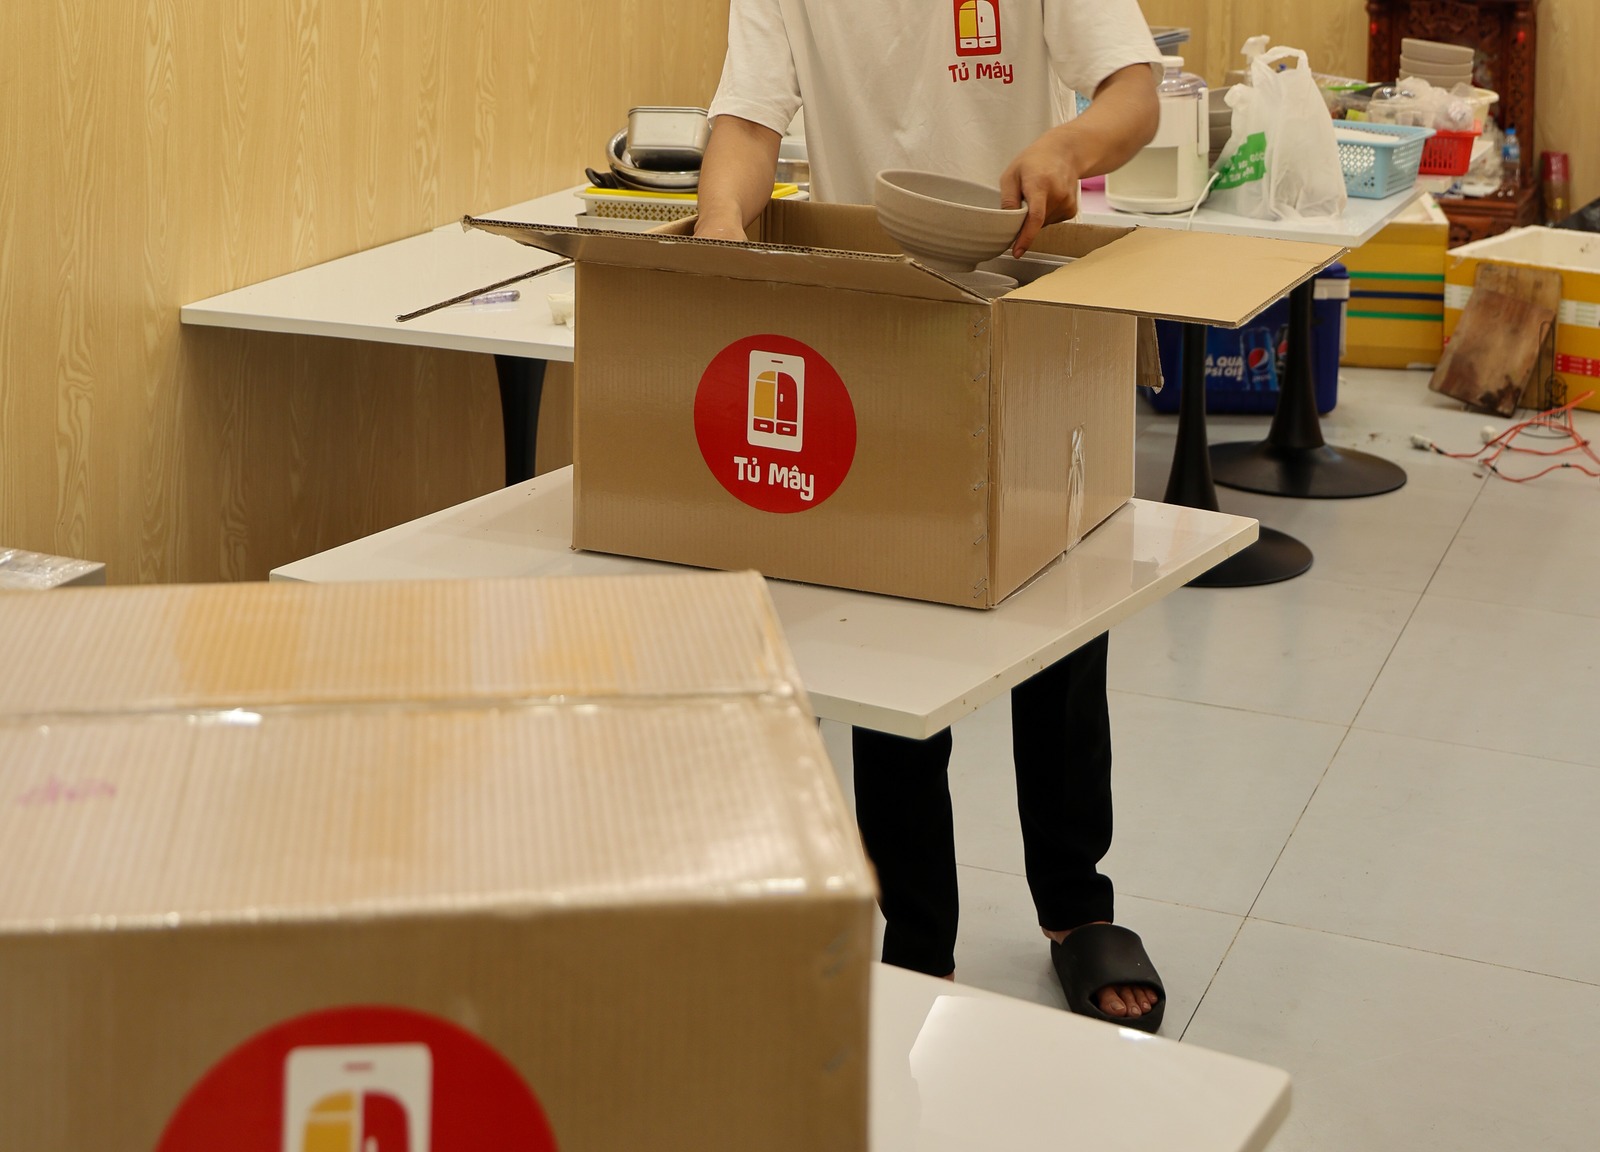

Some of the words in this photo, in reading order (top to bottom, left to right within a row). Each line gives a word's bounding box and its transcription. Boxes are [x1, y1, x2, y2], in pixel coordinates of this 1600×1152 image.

[948, 62, 970, 83] Tủ
[976, 61, 1014, 84] Mây
[733, 456, 760, 483] Tủ
[768, 463, 815, 501] Mây
